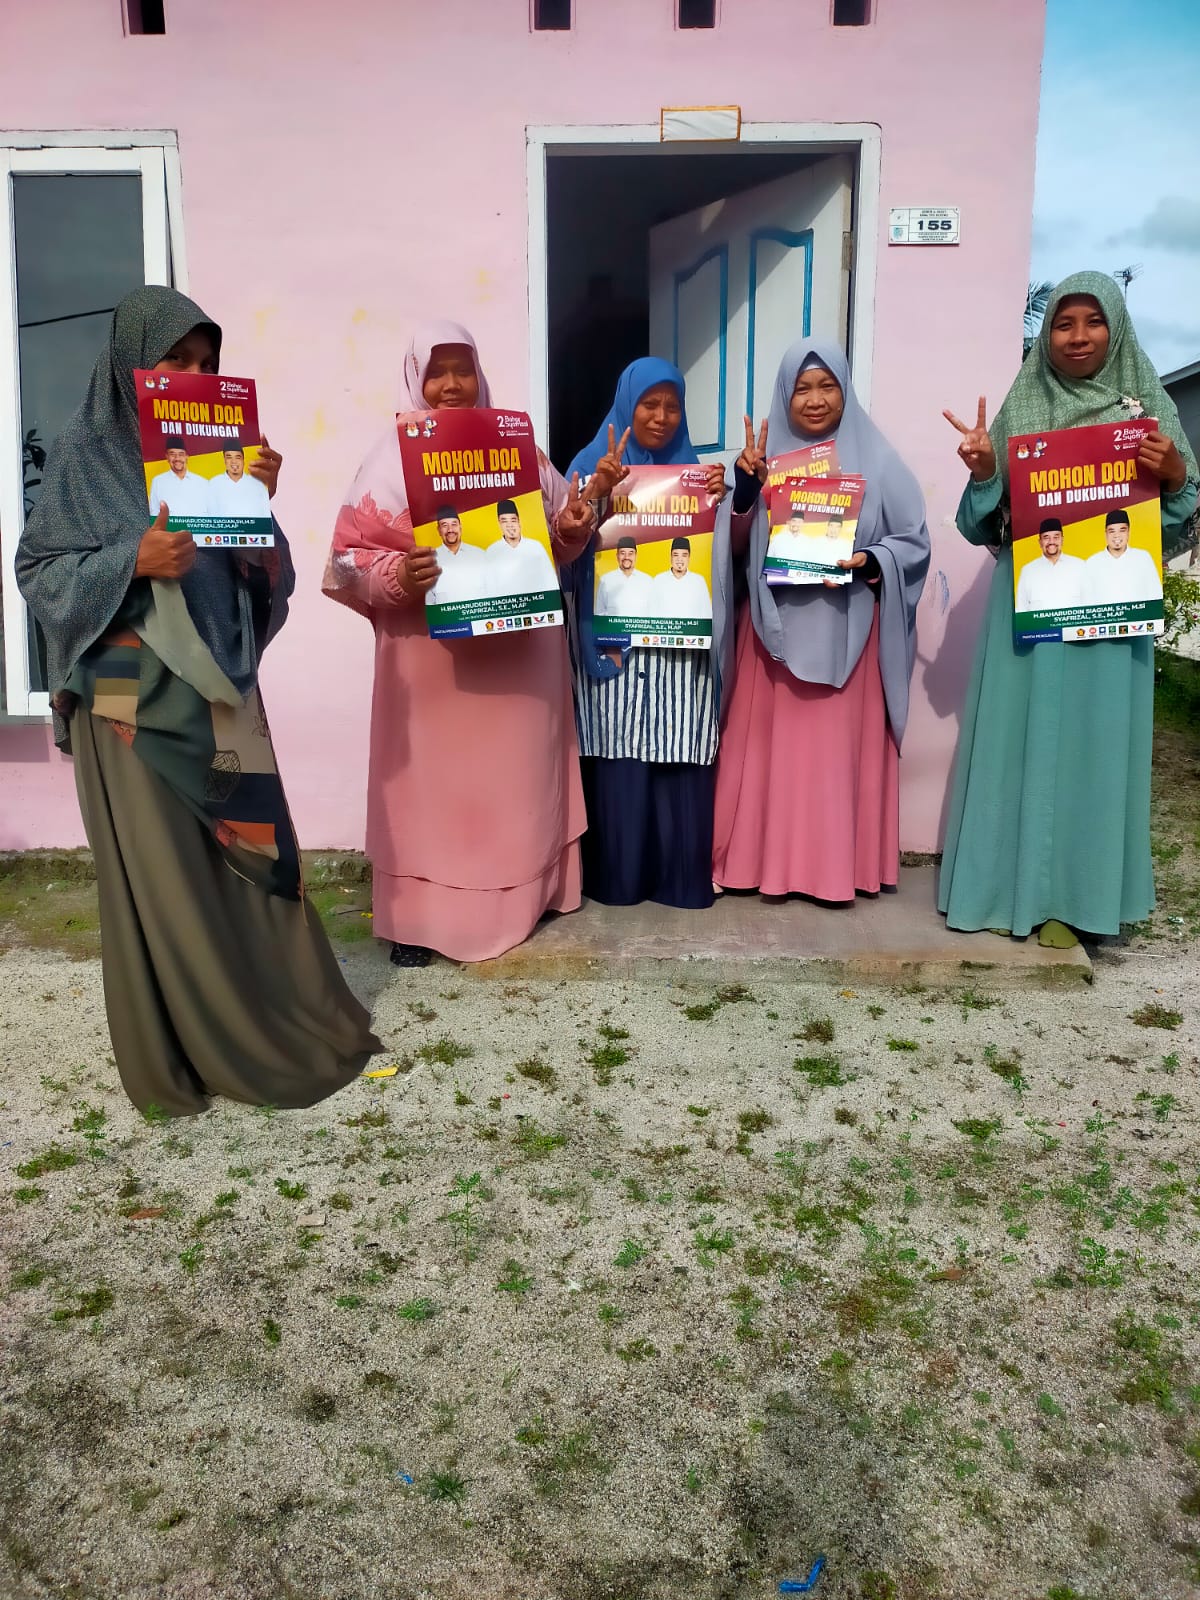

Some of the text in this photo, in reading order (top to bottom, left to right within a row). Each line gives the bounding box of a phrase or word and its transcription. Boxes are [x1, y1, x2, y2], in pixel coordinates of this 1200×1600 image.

[918, 220, 952, 230] 155
[220, 381, 226, 391] 2
[153, 399, 244, 425] MOHON DOA
[161, 421, 239, 437] DAN DUKUNGAN
[497, 416, 505, 427] 2
[1114, 430, 1122, 442] 2
[422, 447, 521, 476] MOHON DOA
[809, 459, 830, 476] DOA
[433, 472, 515, 492] DAN DUKUNGAN
[682, 470, 689, 479] 2
[1030, 459, 1138, 493] MOHON DOA
[790, 490, 852, 507] MOHON DOA
[1038, 483, 1130, 507] DAN DUKUNGAN
[670, 495, 699, 513] DOA
[792, 502, 844, 514] DAN DUKUNGAN
[619, 514, 692, 527] DAN DUKUNGAN
[1033, 609, 1085, 619] H.BAHARUDDIN
